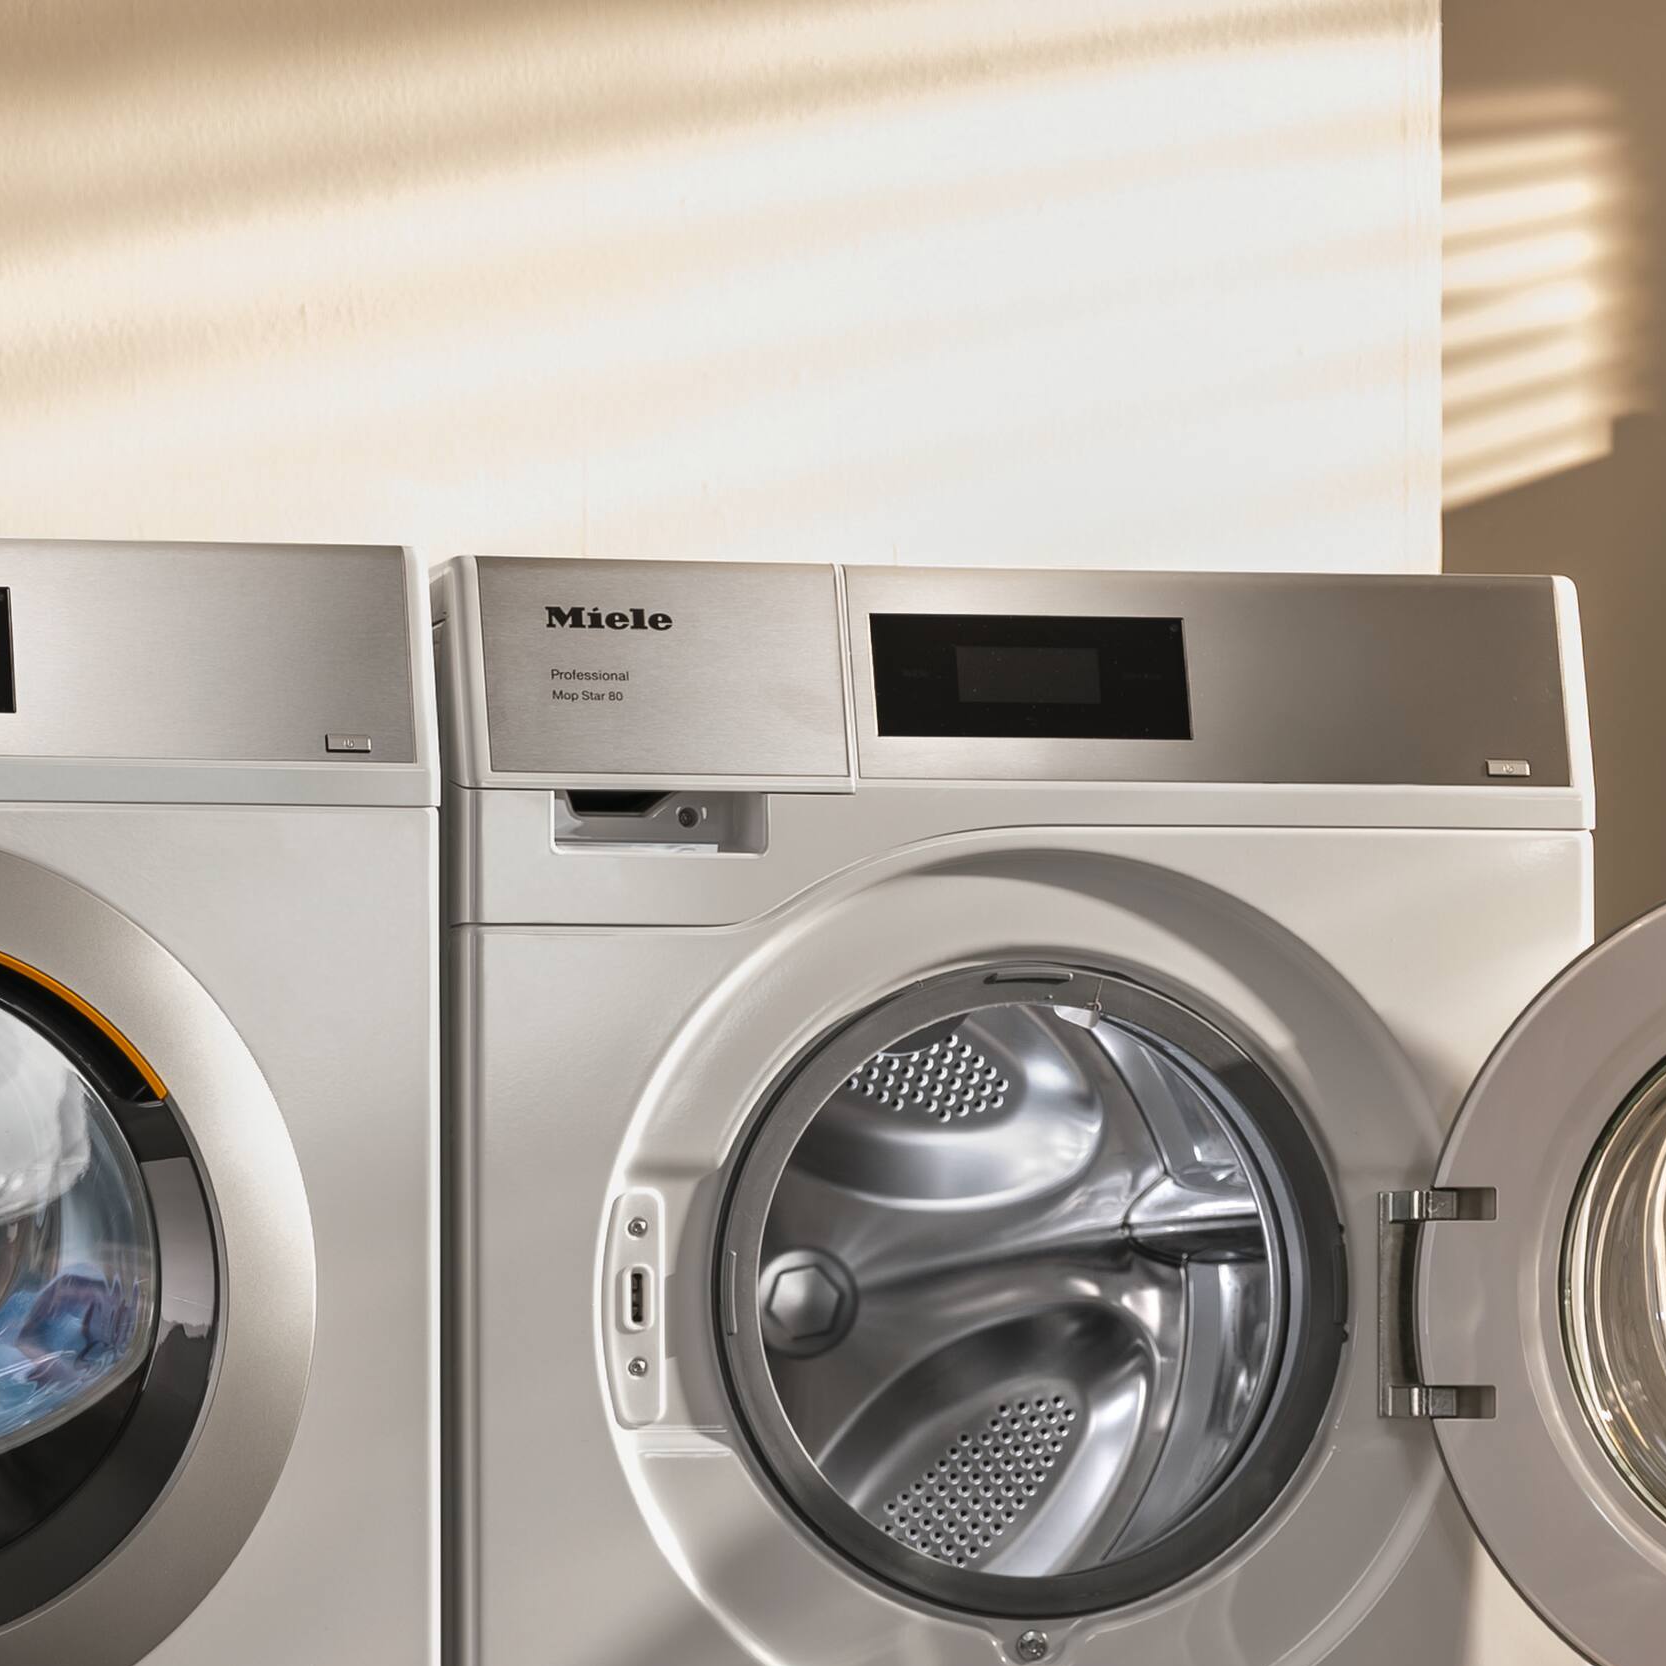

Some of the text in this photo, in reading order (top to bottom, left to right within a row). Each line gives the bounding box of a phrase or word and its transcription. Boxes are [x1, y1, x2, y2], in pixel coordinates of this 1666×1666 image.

[545, 606, 673, 631] Miele
[550, 668, 630, 681] Professional
[552, 689, 623, 702] Mop Star 80
